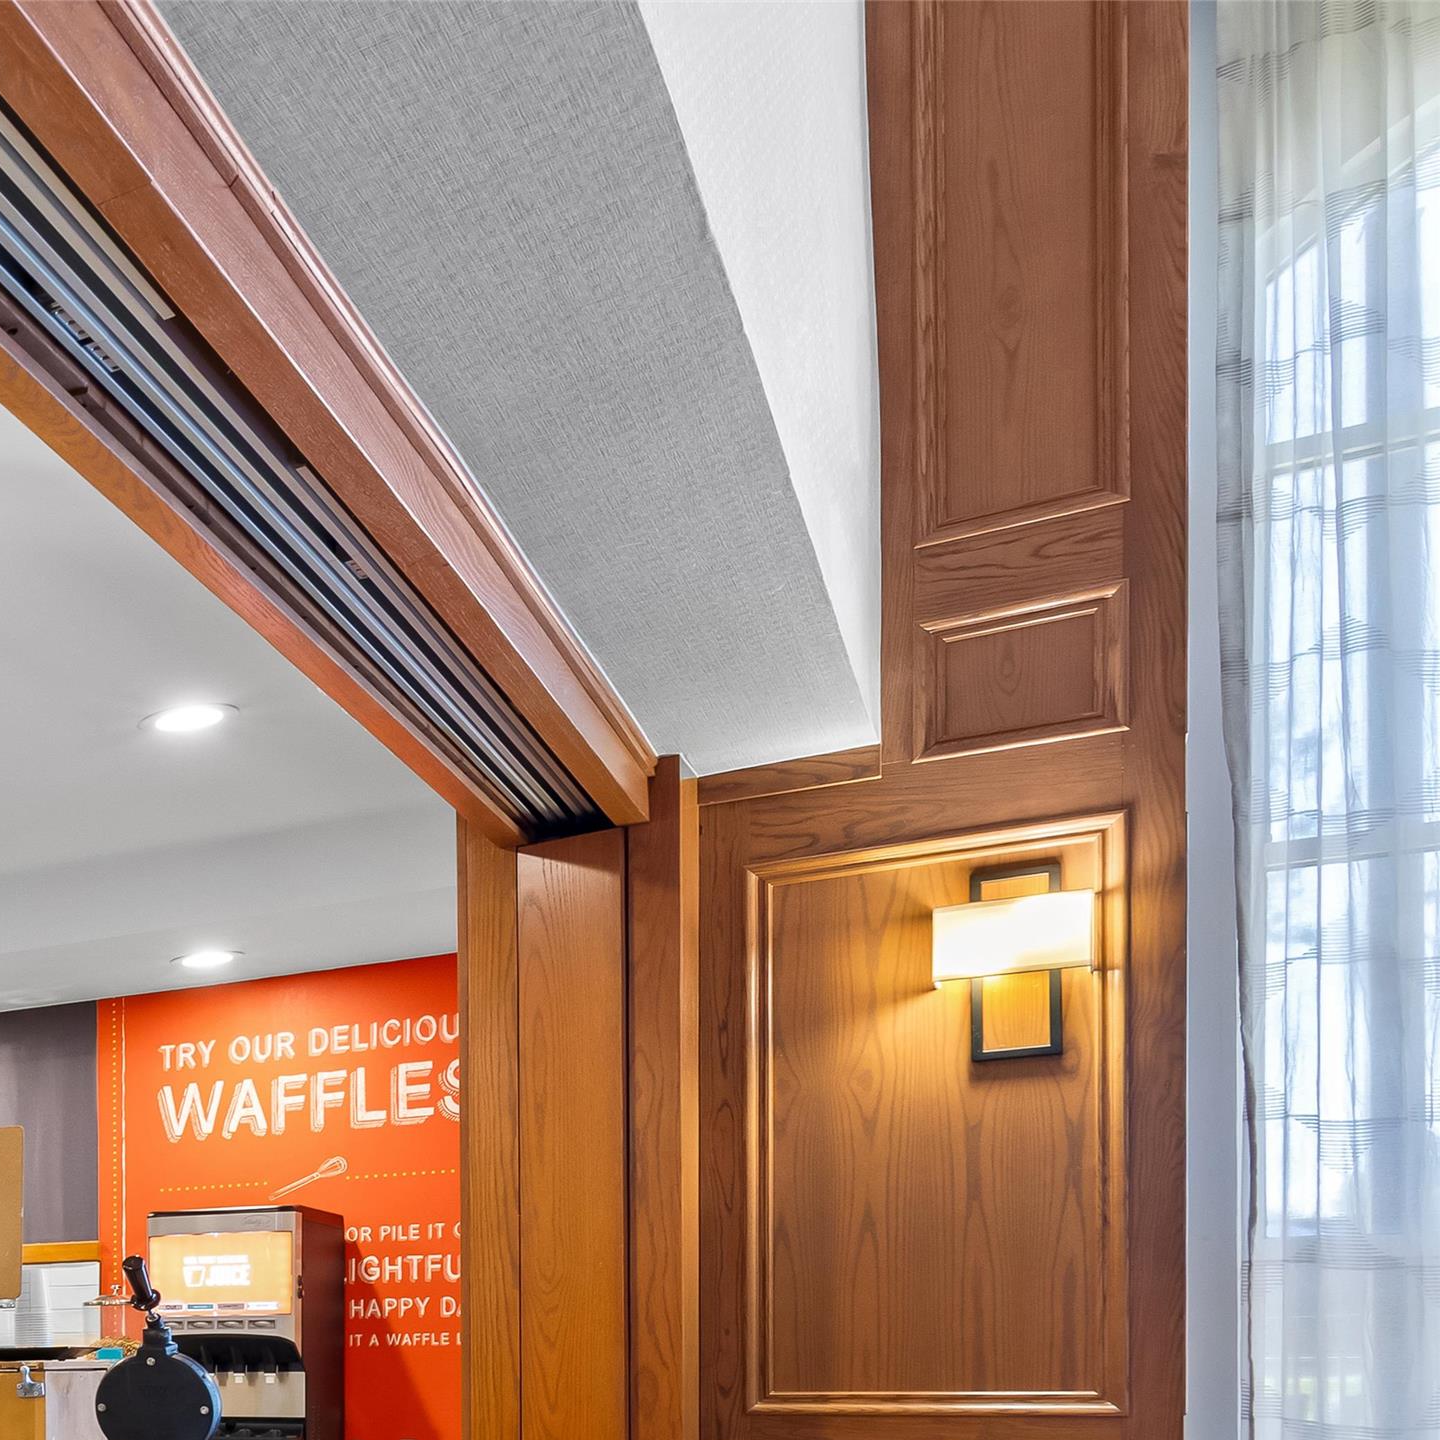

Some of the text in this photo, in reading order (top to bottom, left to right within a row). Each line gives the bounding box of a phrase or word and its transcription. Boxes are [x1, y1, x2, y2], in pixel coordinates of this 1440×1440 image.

[158, 1040, 216, 1071] TRY
[228, 1032, 295, 1064] OUR
[344, 1226, 372, 1242] OR
[379, 1224, 420, 1241] PILE
[427, 1222, 445, 1240] IT
[344, 1254, 461, 1284] IGHTFU
[350, 1296, 461, 1319] HAPPY D
[349, 1333, 363, 1347] IT
[369, 1333, 379, 1346] A
[386, 1332, 449, 1346] WAFFLE
